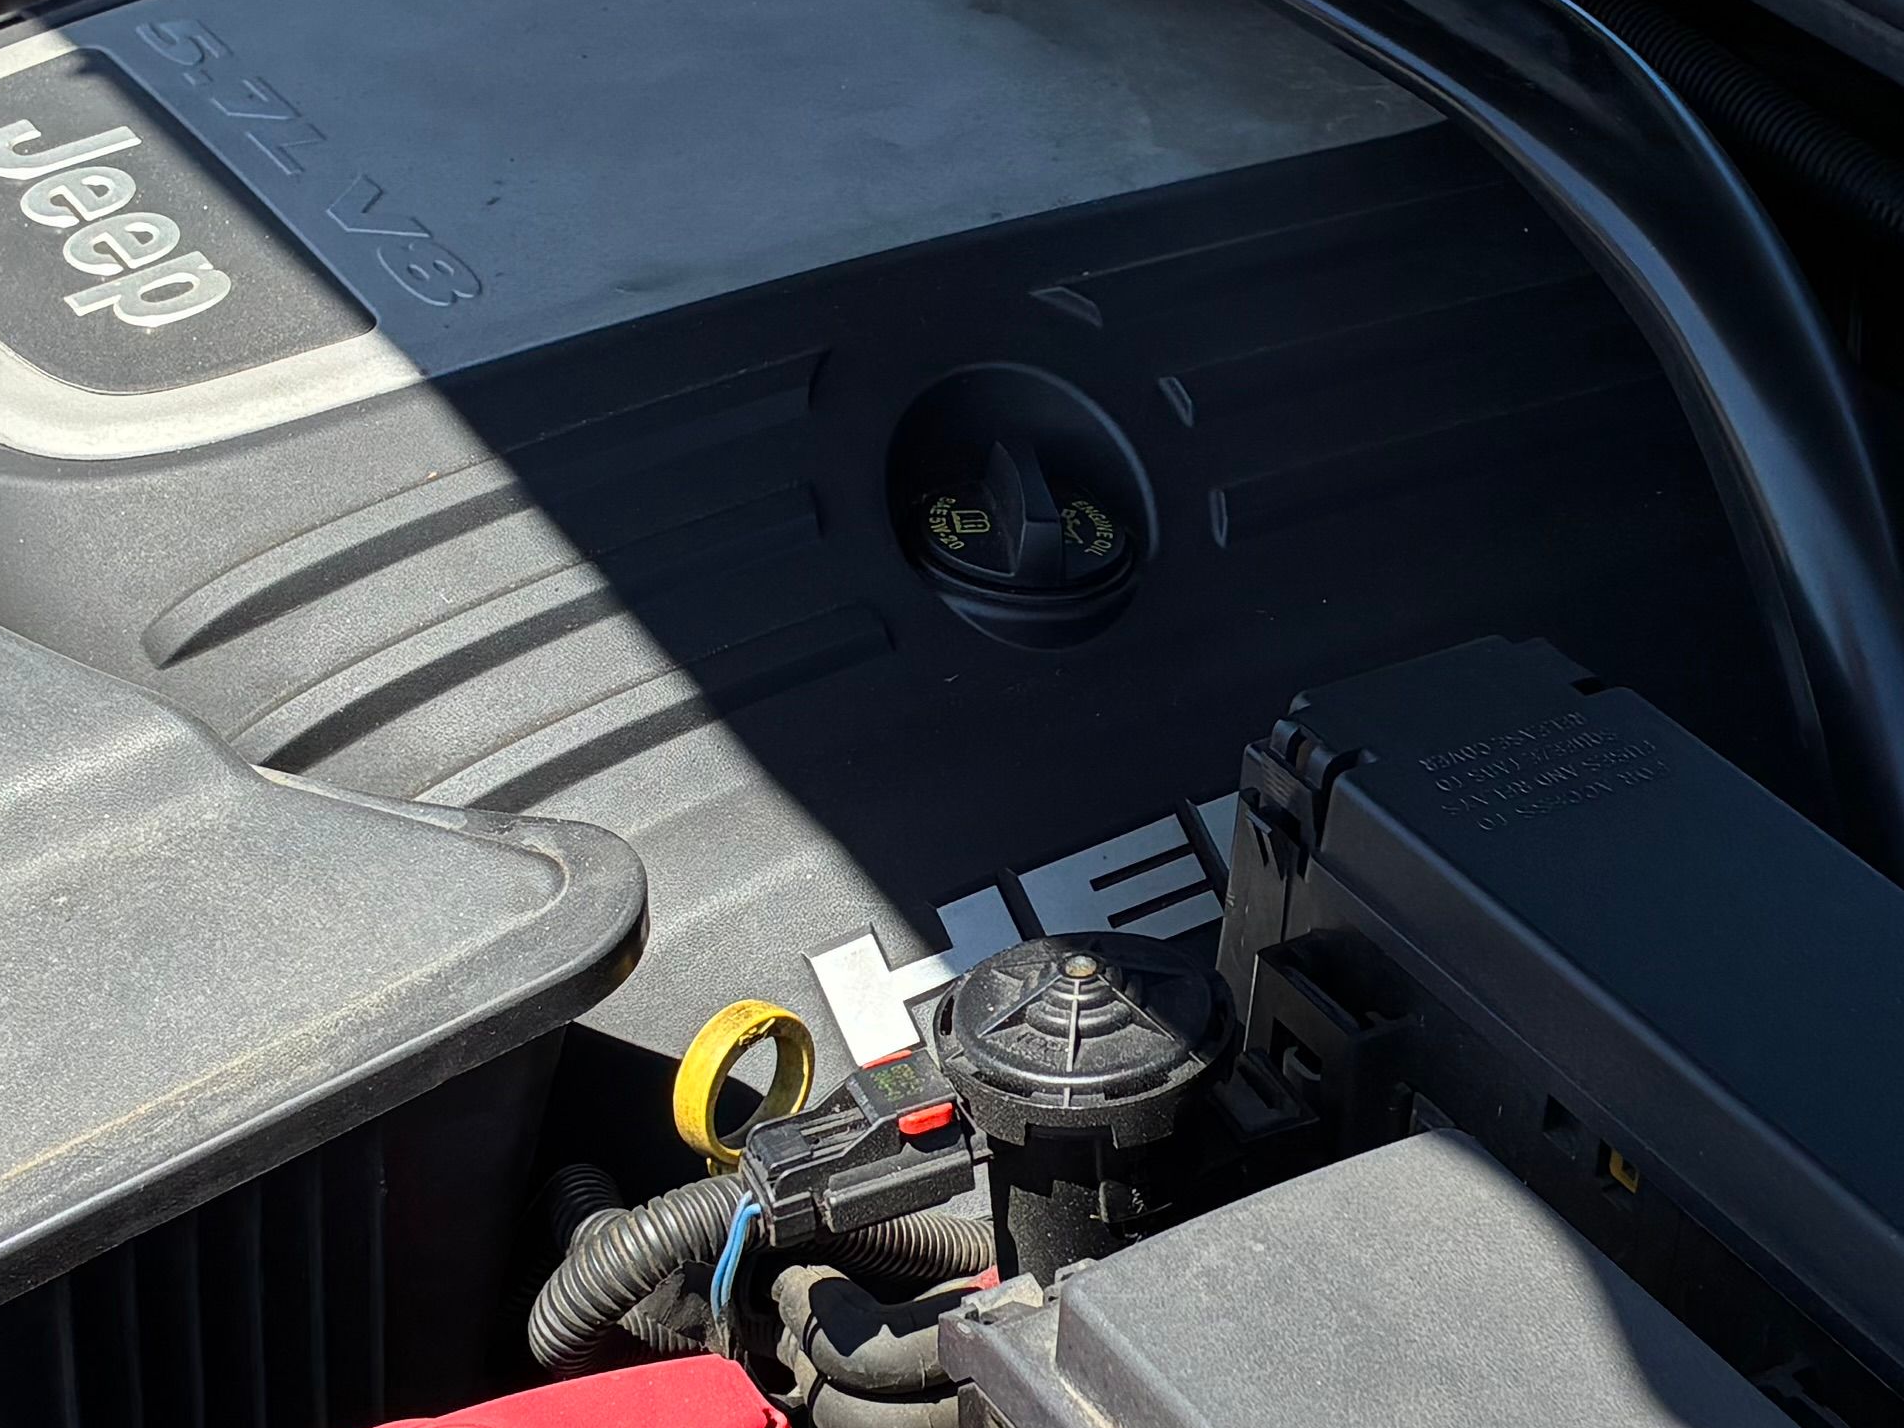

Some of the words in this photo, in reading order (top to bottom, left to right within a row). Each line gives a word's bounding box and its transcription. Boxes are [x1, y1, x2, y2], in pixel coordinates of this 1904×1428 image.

[324, 174, 484, 307] V8
[1071, 500, 1113, 540] ENGINE
[1084, 539, 1112, 557] OIL
[1418, 740, 1491, 772] COVER
[1534, 764, 1579, 788] AND
